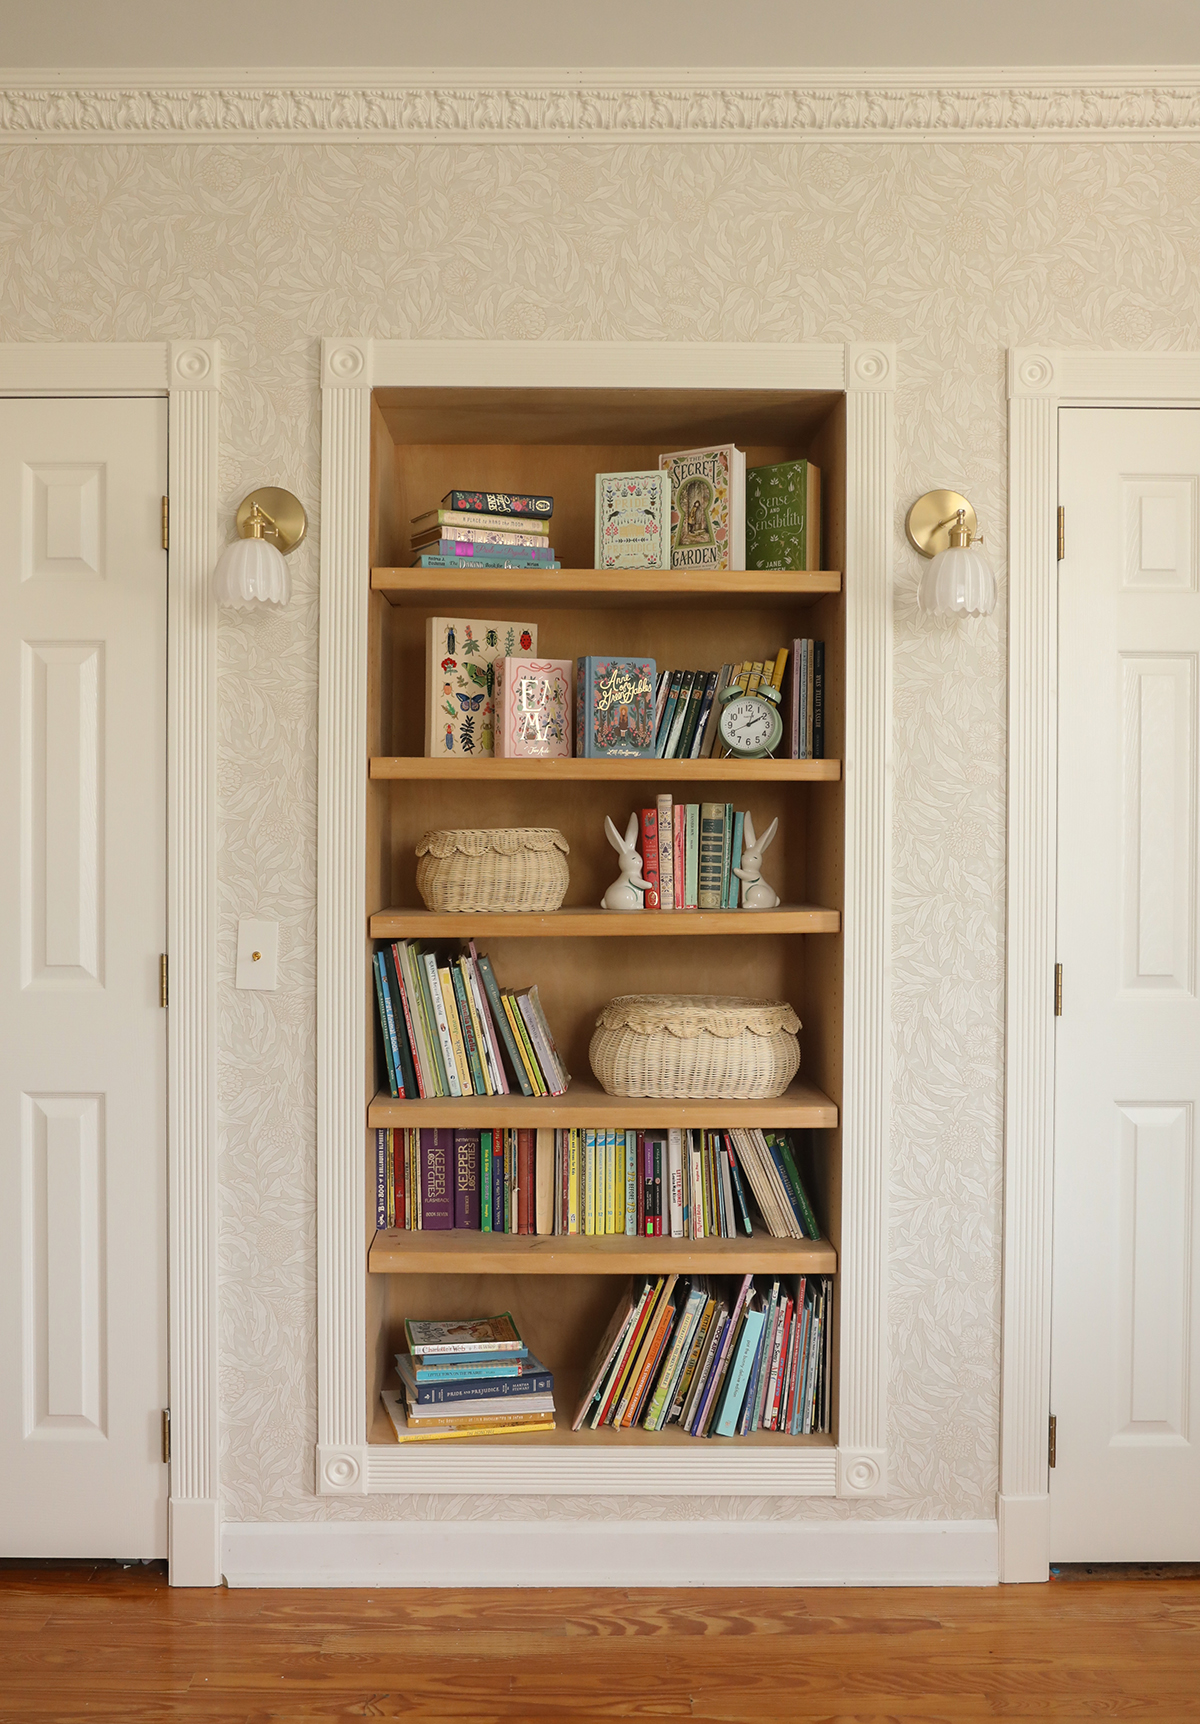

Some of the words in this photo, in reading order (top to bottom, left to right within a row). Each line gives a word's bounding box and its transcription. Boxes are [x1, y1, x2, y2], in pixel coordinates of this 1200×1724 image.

[673, 460, 718, 489] SECRET
[615, 498, 649, 509] PRIDE
[755, 495, 790, 520] Sense
[746, 508, 804, 541] Sensibility
[607, 543, 657, 553] PREJUDICE
[672, 547, 717, 567] GARDEN
[765, 560, 782, 568] JANE
[600, 669, 631, 691] Anne
[746, 704, 753, 712] 12
[762, 712, 767, 720] 2
[765, 721, 770, 729] 3
[428, 960, 436, 980] SAINTS
[451, 1019, 459, 1034] Jane
[460, 999, 470, 1023] Amelia
[465, 1024, 476, 1052] Bedelia
[454, 1039, 463, 1054] Dick
[427, 1149, 436, 1169] LOST
[458, 1144, 467, 1190] KEEPER
[435, 1149, 445, 1197] KEEPER
[427, 1171, 436, 1197] CITIES
[676, 1314, 691, 1343] ILLUSTRATED
[699, 1313, 710, 1333] PICTURE
[694, 1335, 703, 1348] BOOK
[713, 1325, 722, 1341] ROCK
[709, 1341, 717, 1353] ART
[667, 1343, 680, 1371] CHILDREN'S
[739, 1354, 747, 1368] bunny
[685, 1358, 695, 1376] SAINTS
[736, 1368, 744, 1382] deluxe
[635, 1372, 647, 1396] STORYBOOK
[662, 1372, 670, 1386] BIBLE
[471, 1387, 500, 1396] PREJUDICE
[732, 1382, 741, 1397] edition
[627, 1396, 638, 1418] FAVORITES
